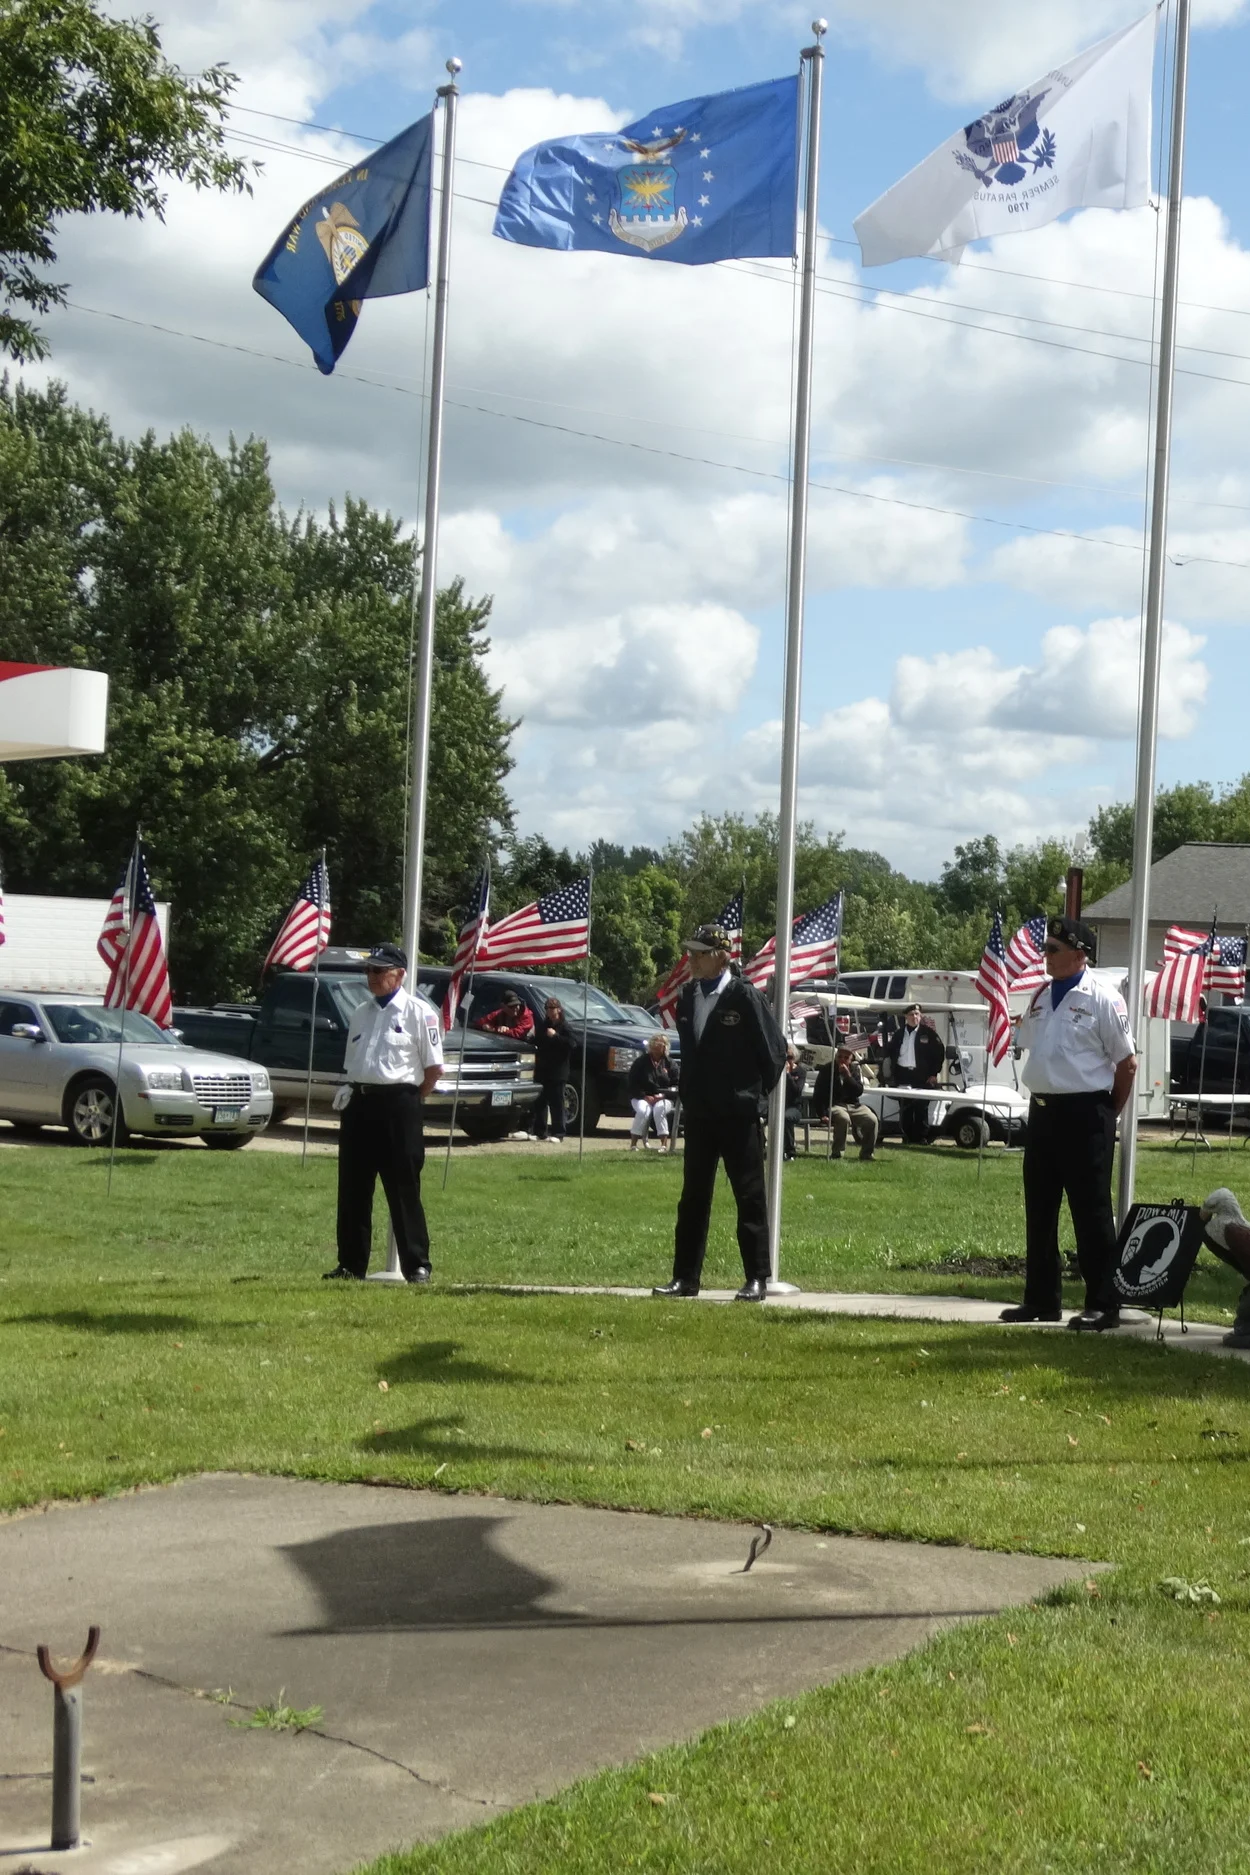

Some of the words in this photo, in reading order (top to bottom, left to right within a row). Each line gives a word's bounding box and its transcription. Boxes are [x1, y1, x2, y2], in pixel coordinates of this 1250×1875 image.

[1130, 1206, 1160, 1233] POW
[1167, 1208, 1188, 1237] MIA
[1137, 1276, 1169, 1297] FORGOTTEN
